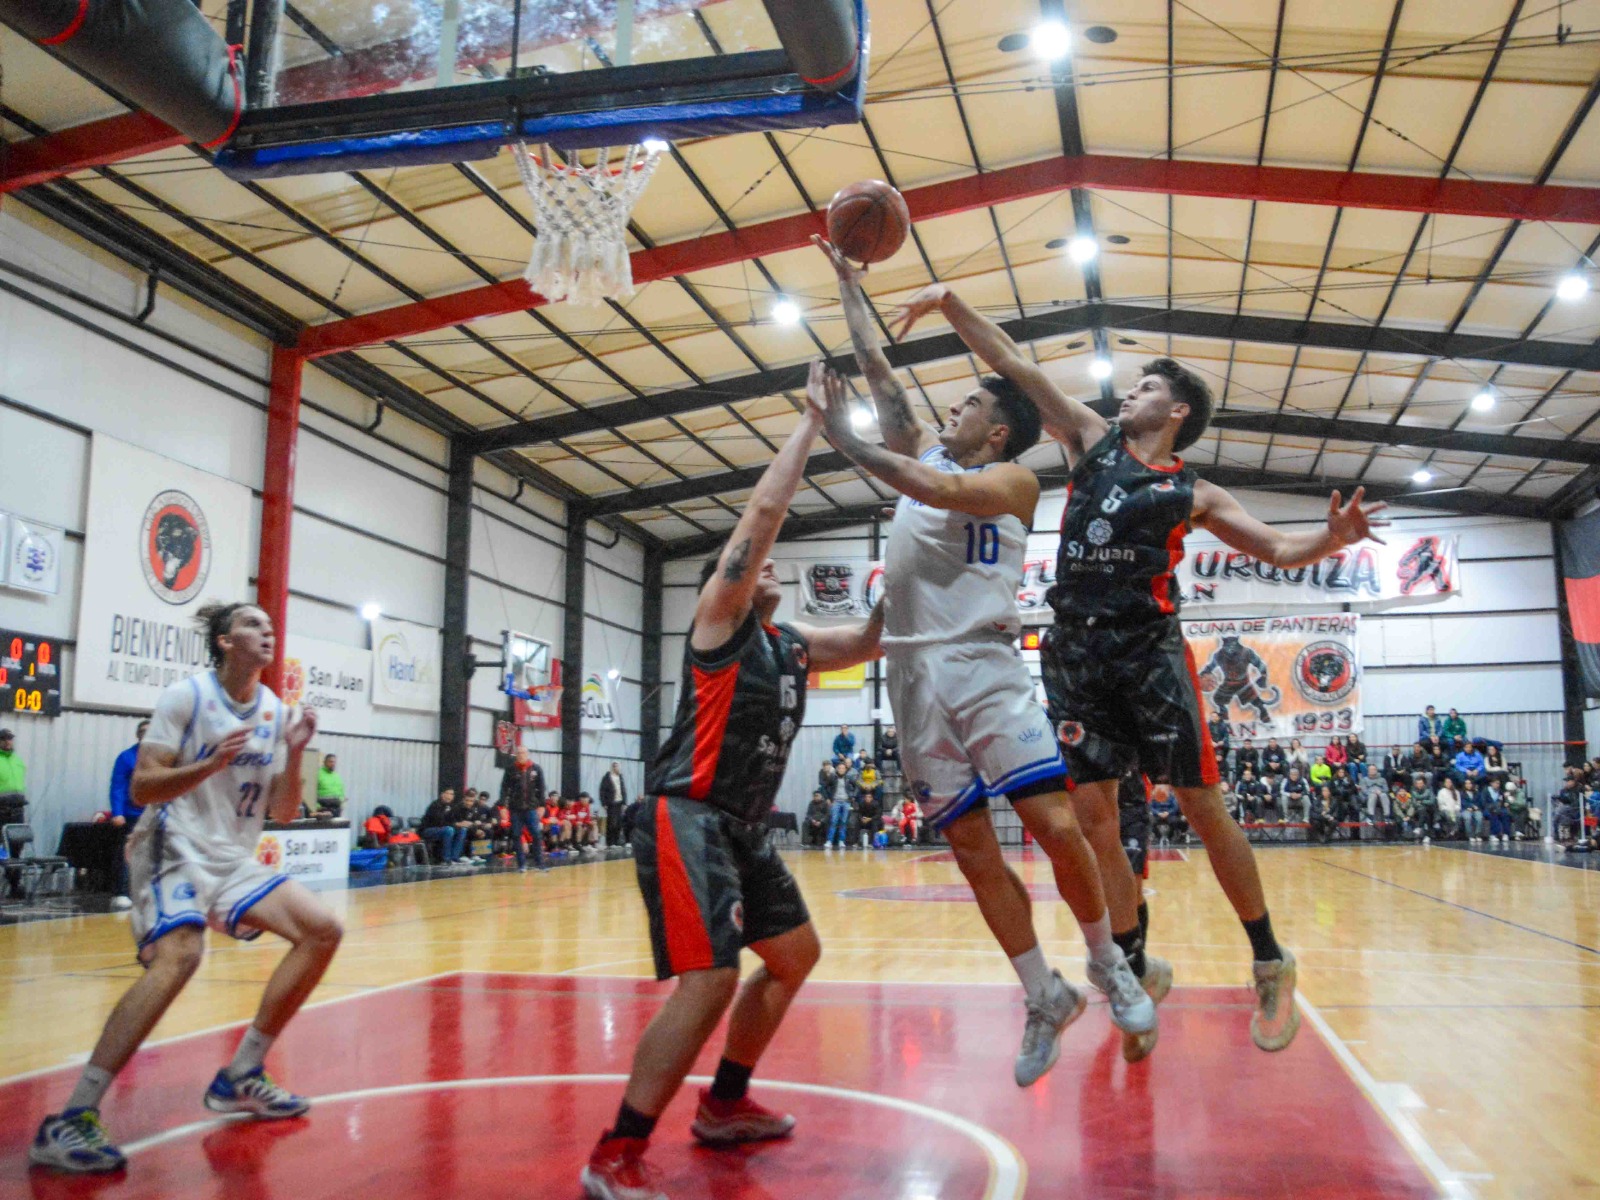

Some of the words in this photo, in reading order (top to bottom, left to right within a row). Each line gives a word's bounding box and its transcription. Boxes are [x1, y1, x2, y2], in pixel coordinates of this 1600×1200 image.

[1101, 484, 1128, 513] 5
[964, 521, 1000, 565] 10
[1086, 546, 1136, 562] Juan
[1188, 622, 1236, 636] CUNA
[1241, 620, 1266, 633] DE
[1271, 615, 1358, 634] PANTERAS
[10, 638, 23, 660] 0
[37, 642, 51, 665] 0
[309, 666, 332, 686] San
[335, 671, 364, 692] Juan
[1295, 707, 1354, 732] 1933
[285, 839, 308, 856] San
[311, 838, 339, 855] Juan
